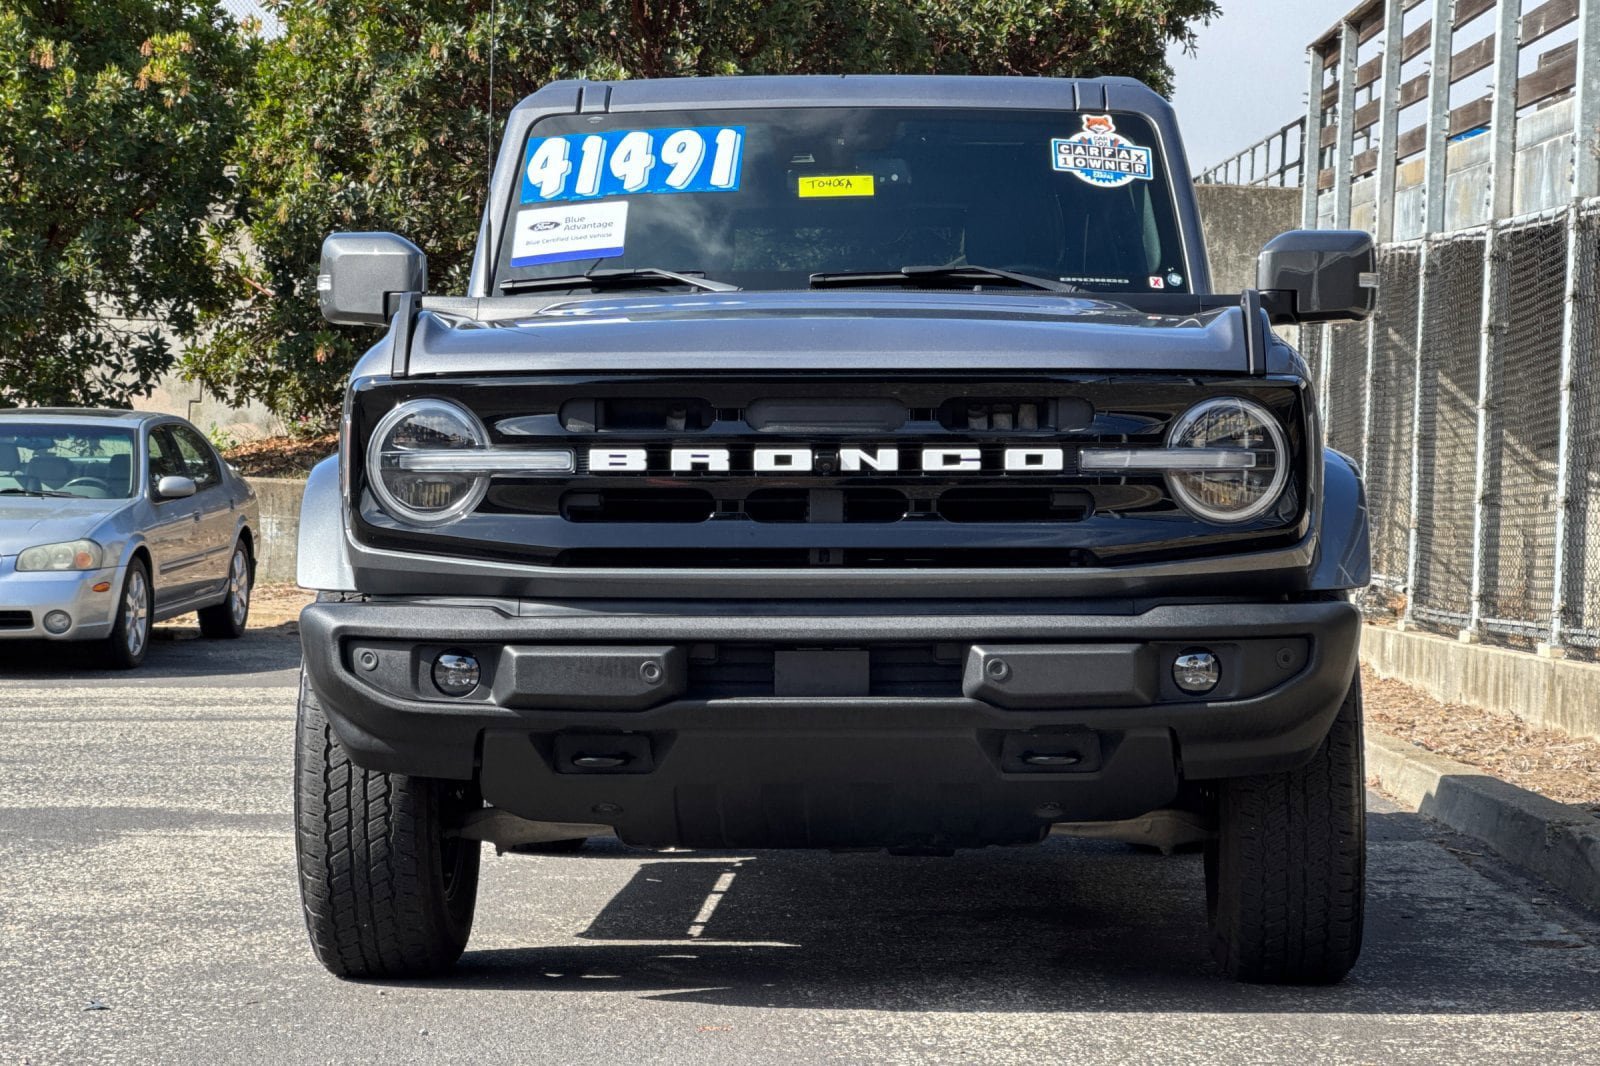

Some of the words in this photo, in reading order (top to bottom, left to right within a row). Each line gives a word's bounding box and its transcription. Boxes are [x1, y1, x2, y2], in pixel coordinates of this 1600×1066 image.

[1059, 145, 1144, 162] CARFAX
[527, 129, 742, 198] 41491
[1062, 157, 1070, 166] 1
[1075, 160, 1145, 174] OWNER
[563, 221, 614, 231] Advantage
[564, 216, 586, 224] Blue
[588, 448, 1064, 472] BRONCO
